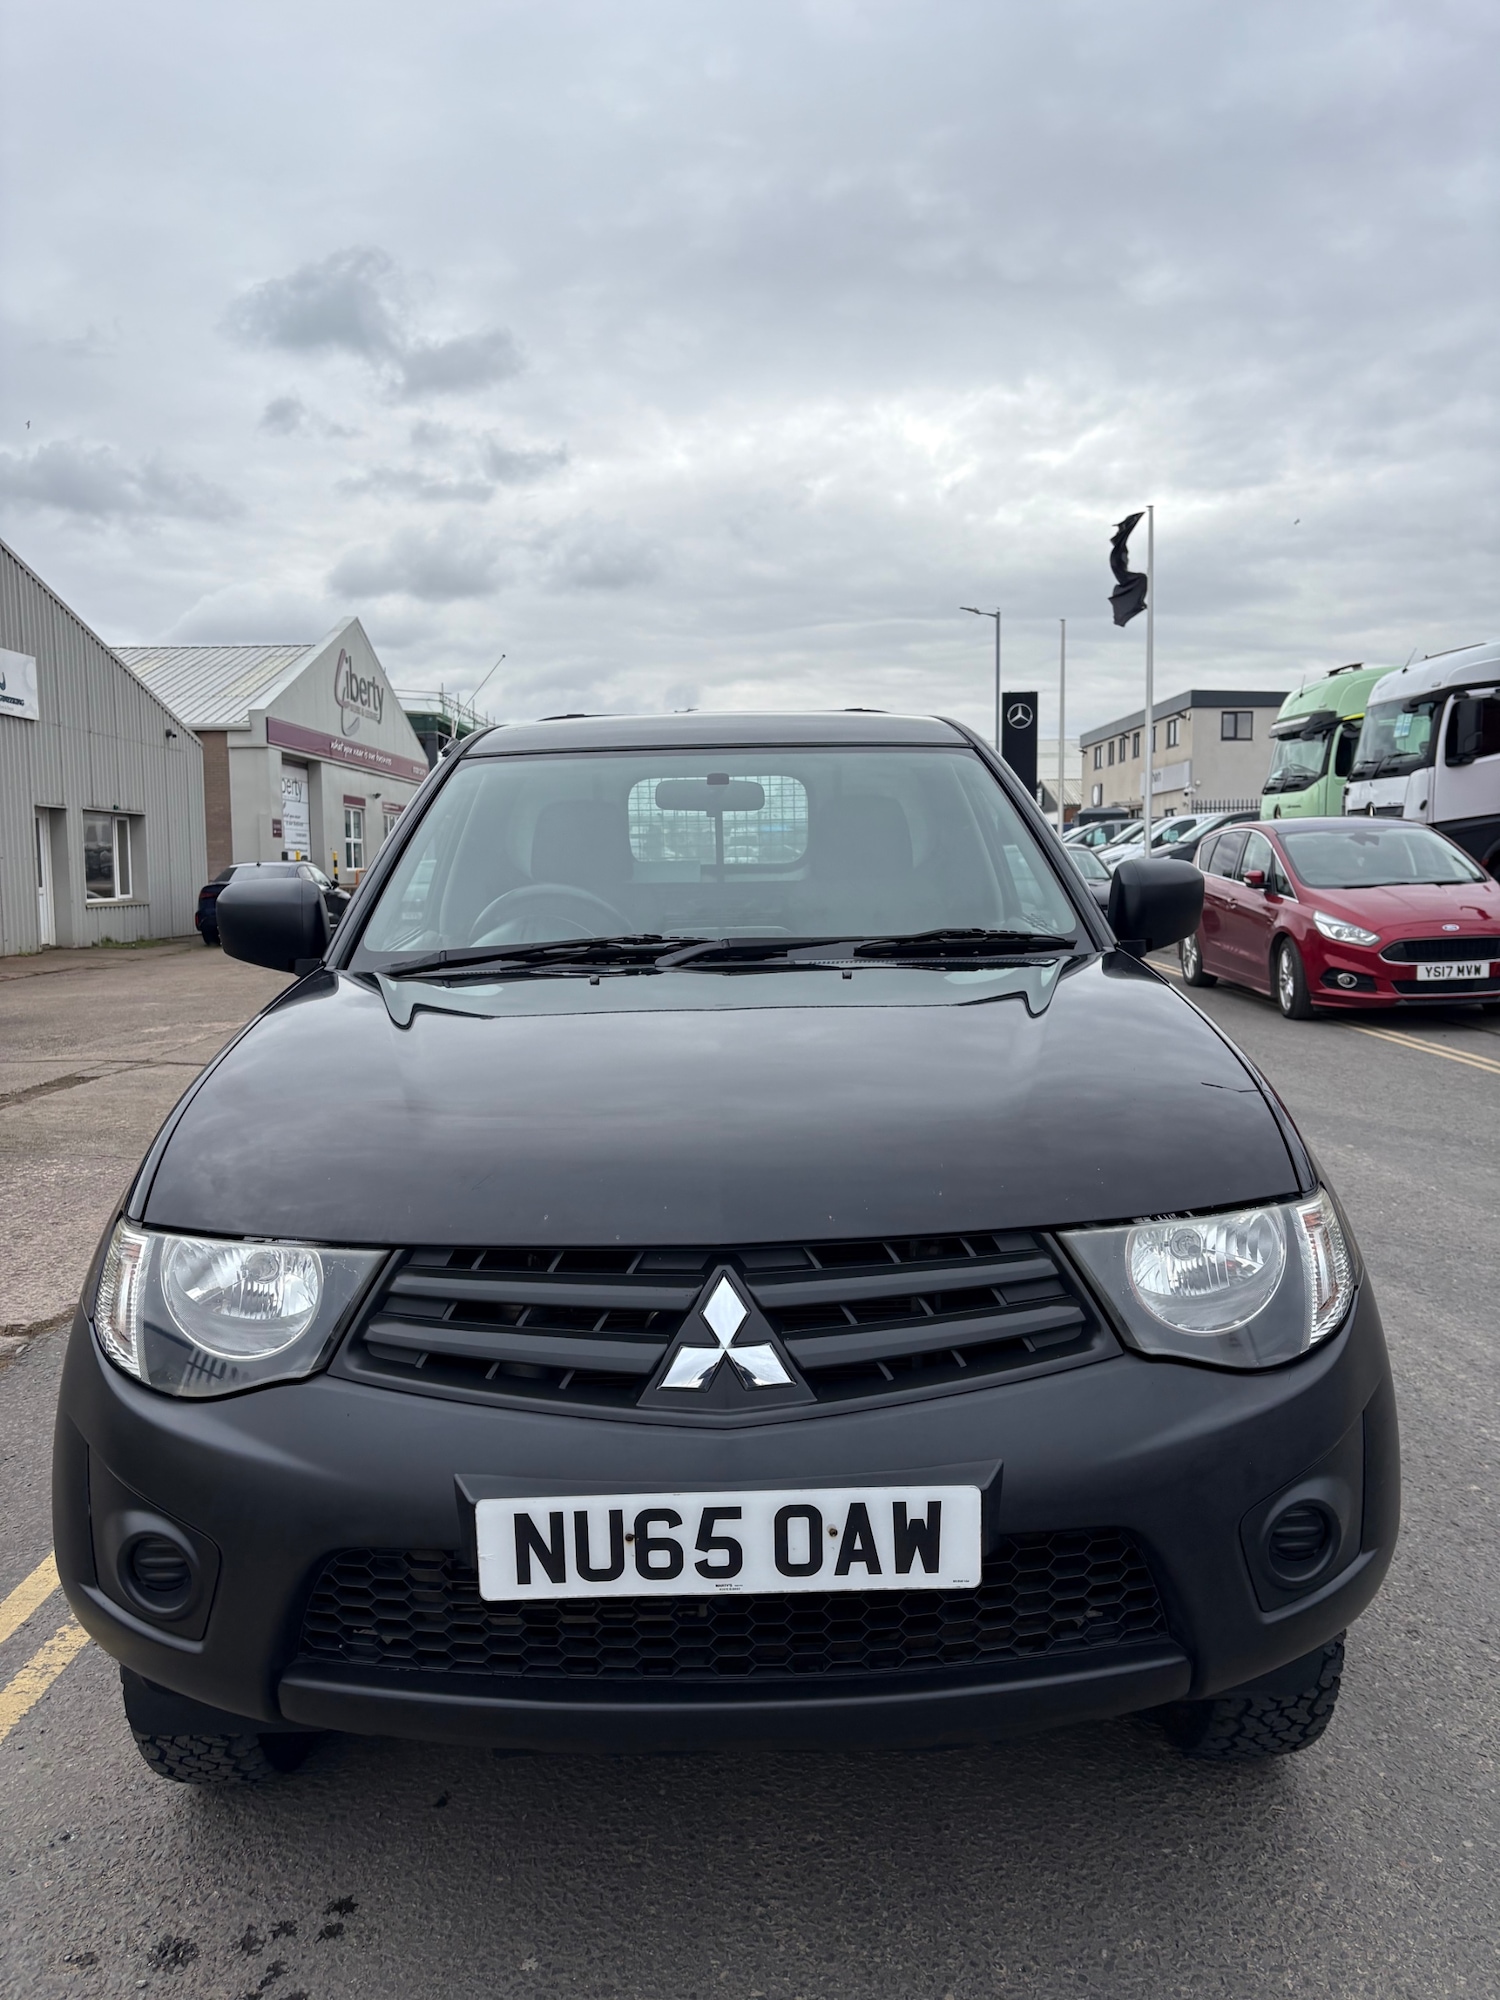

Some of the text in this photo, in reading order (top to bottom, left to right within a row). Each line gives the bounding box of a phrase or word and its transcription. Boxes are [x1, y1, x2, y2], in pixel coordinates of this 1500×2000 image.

[334, 648, 384, 725] Liberty
[1425, 964, 1482, 978] YS17 MVW
[513, 1501, 942, 1585] NU65 OAW
